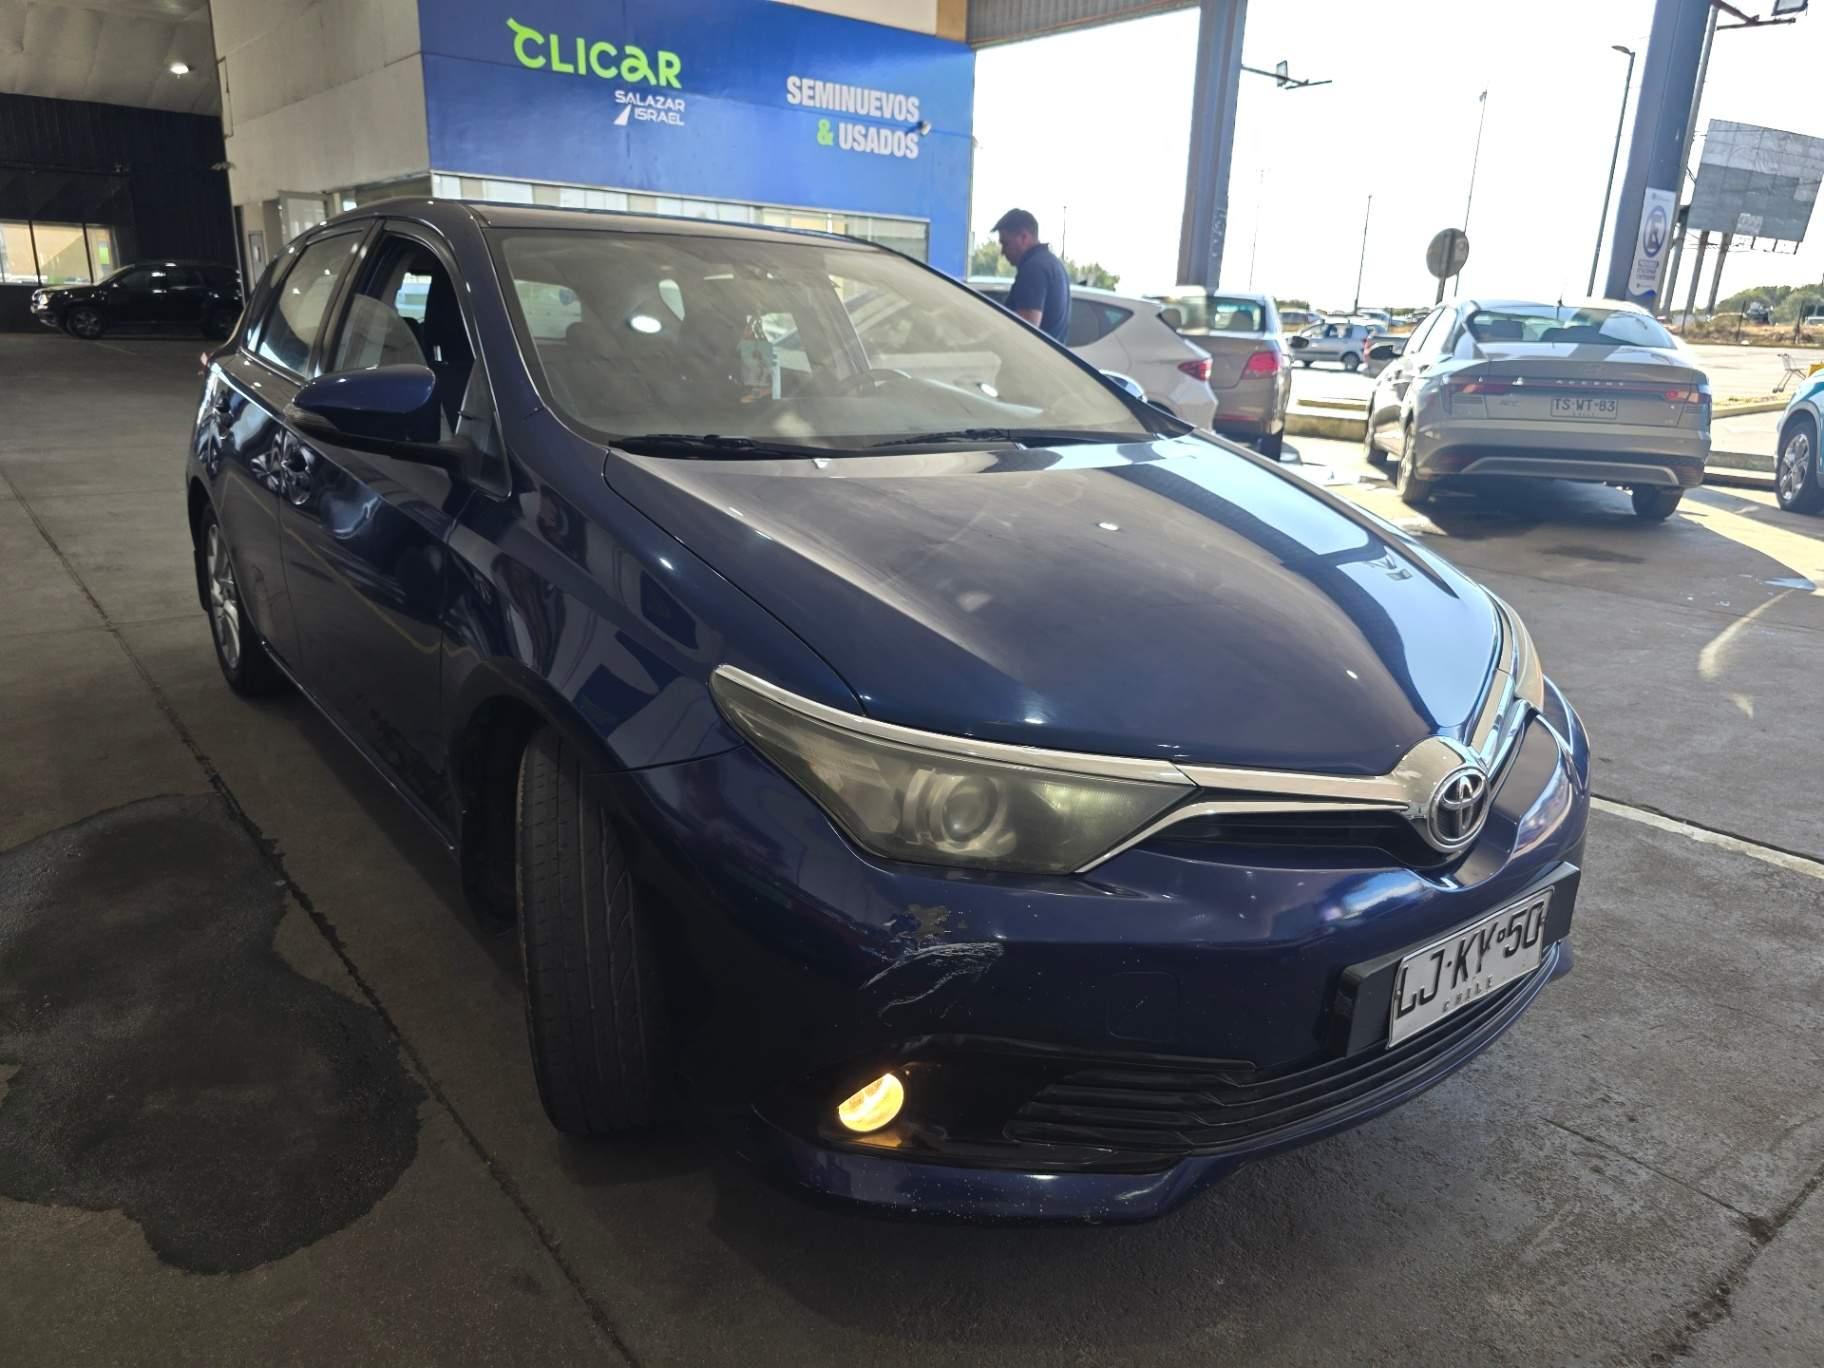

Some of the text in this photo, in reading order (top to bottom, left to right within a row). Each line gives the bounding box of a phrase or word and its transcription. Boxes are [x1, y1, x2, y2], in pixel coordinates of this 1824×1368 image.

[614, 90, 686, 112] SALAZAR
[634, 108, 685, 126] ISRAEL
[786, 75, 920, 123] SEMINUEVOS
[817, 118, 919, 159] & USADOS
[1442, 975, 1493, 1013] CHILE
